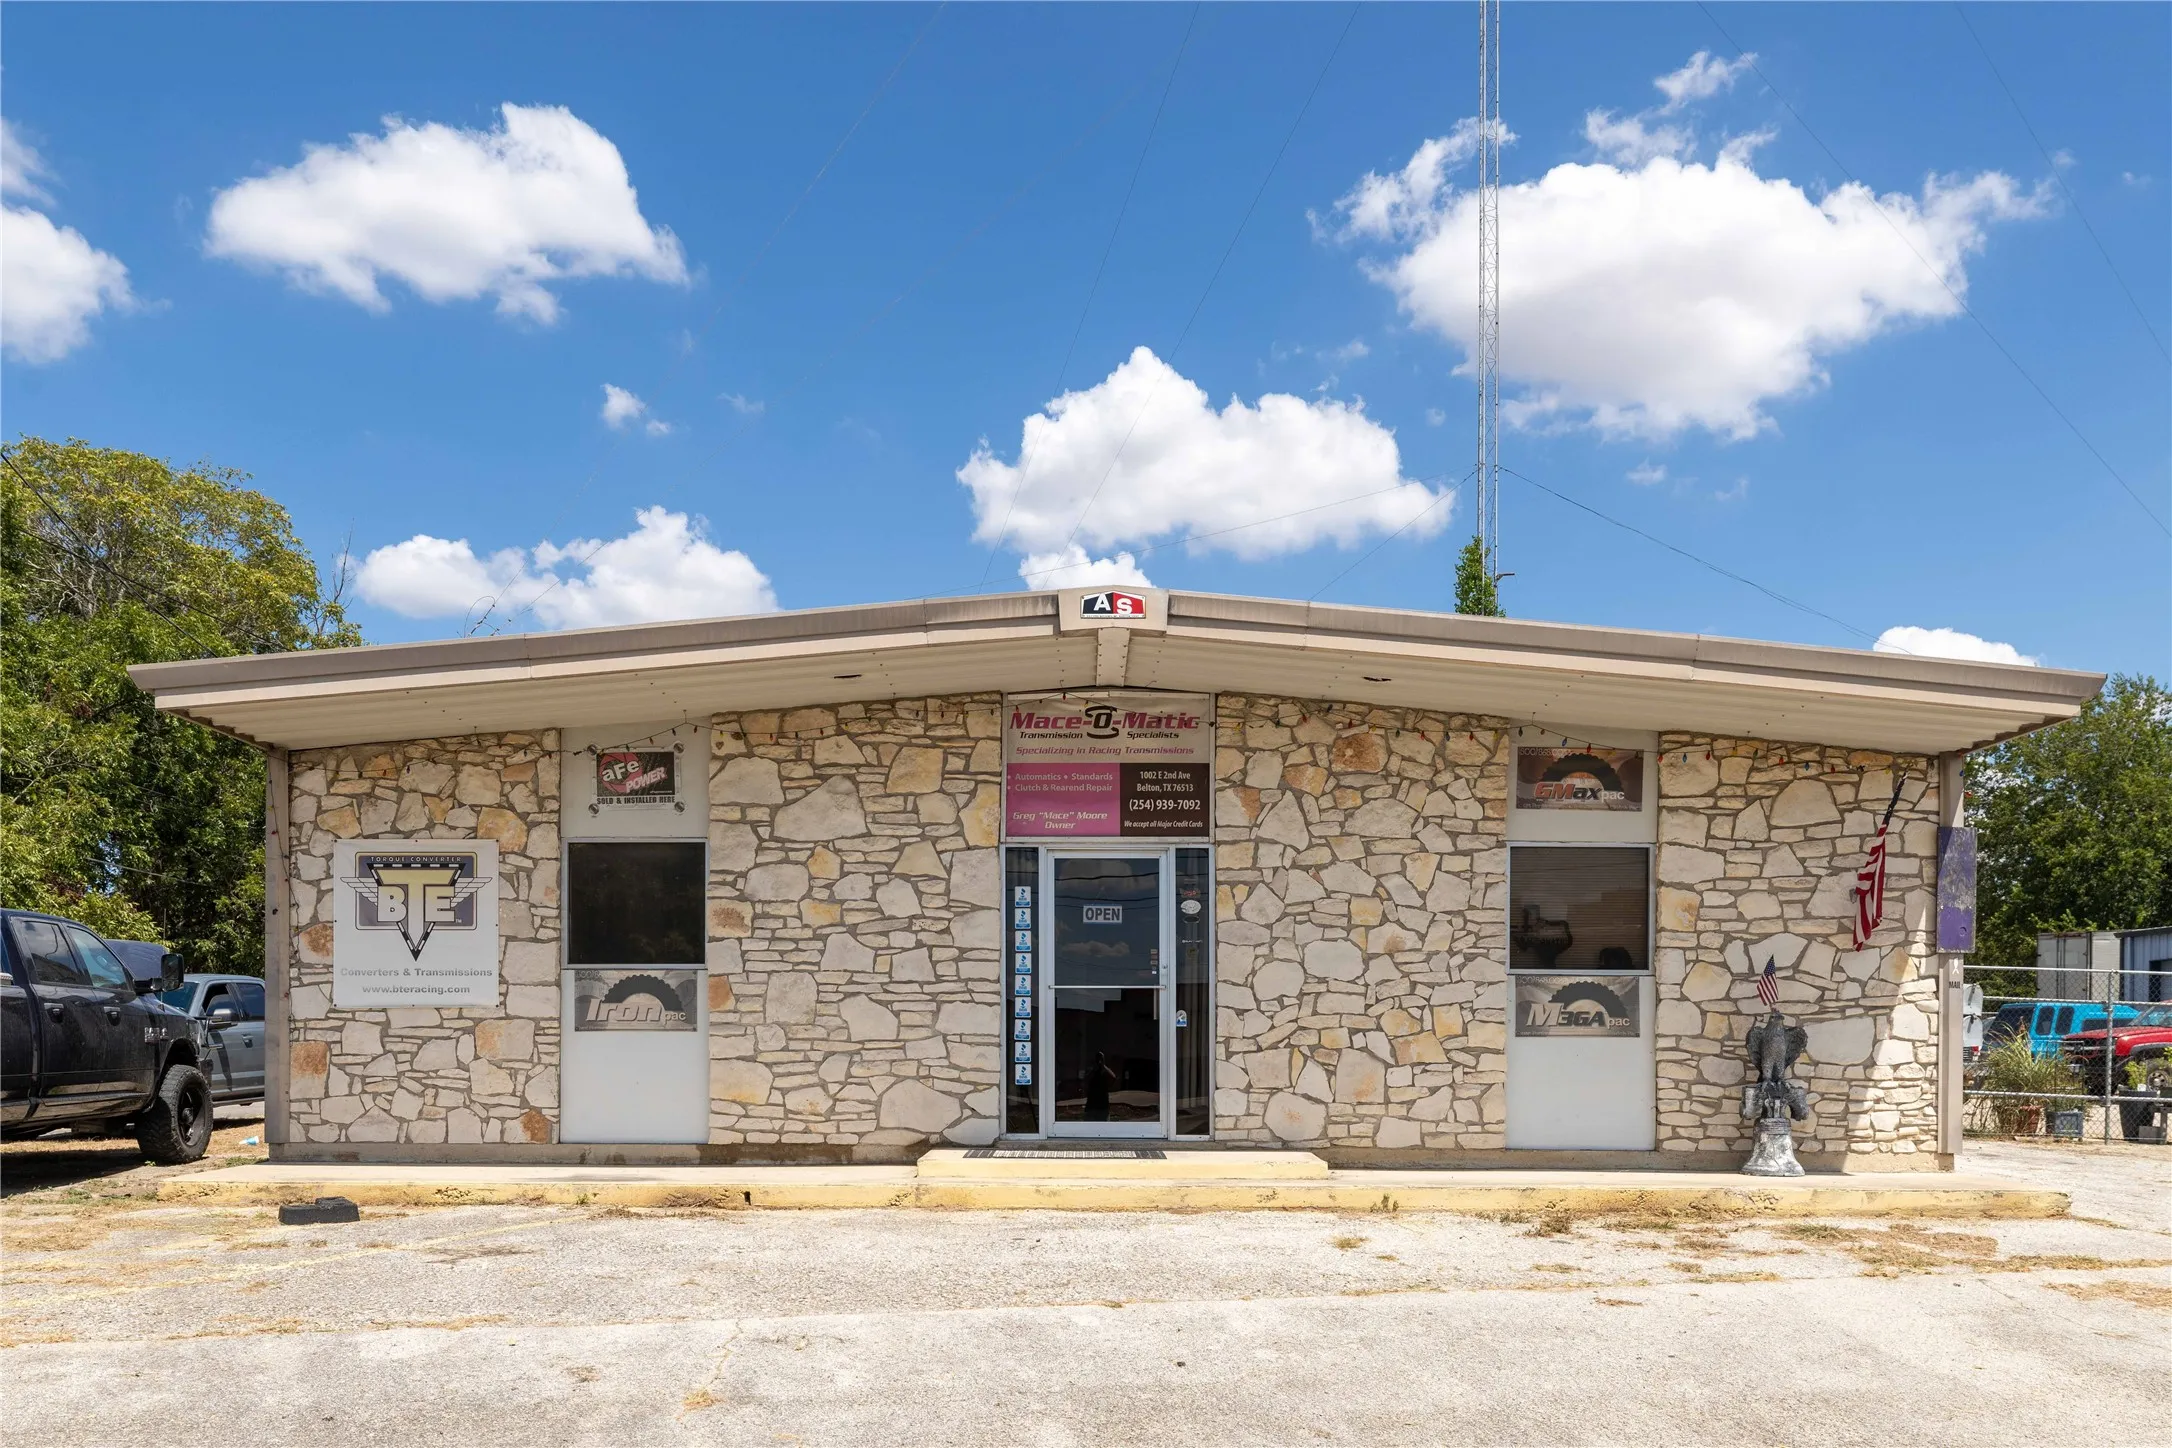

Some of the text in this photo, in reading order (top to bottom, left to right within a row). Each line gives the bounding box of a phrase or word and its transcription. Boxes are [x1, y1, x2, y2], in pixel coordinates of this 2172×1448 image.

[1094, 592, 1132, 614] AS
[1010, 711, 1200, 730] Mace-O-Matic
[1020, 731, 1179, 740] Transmission Specialists
[1016, 746, 1194, 755] Specializing in Racing Transmissions
[602, 760, 640, 781] aFe
[1163, 771, 1177, 779] 2nd
[625, 766, 666, 793] POWER
[1015, 772, 1113, 780] Automatics Standards
[1086, 783, 1112, 793] Repair
[1137, 783, 1162, 792] Belton,
[1601, 790, 1625, 802] pac
[1129, 799, 1200, 812] (254) 939-7092
[1013, 812, 1035, 820] Greg
[1044, 821, 1076, 829] Owner
[1157, 820, 1172, 829] Major
[375, 867, 458, 953] BTE
[1085, 907, 1120, 921] OPEN
[341, 968, 492, 976] Converters & Transmissions
[362, 985, 470, 995] www.bteracing.com
[585, 998, 686, 1023] Iron pac
[1608, 1017, 1630, 1029] pac
